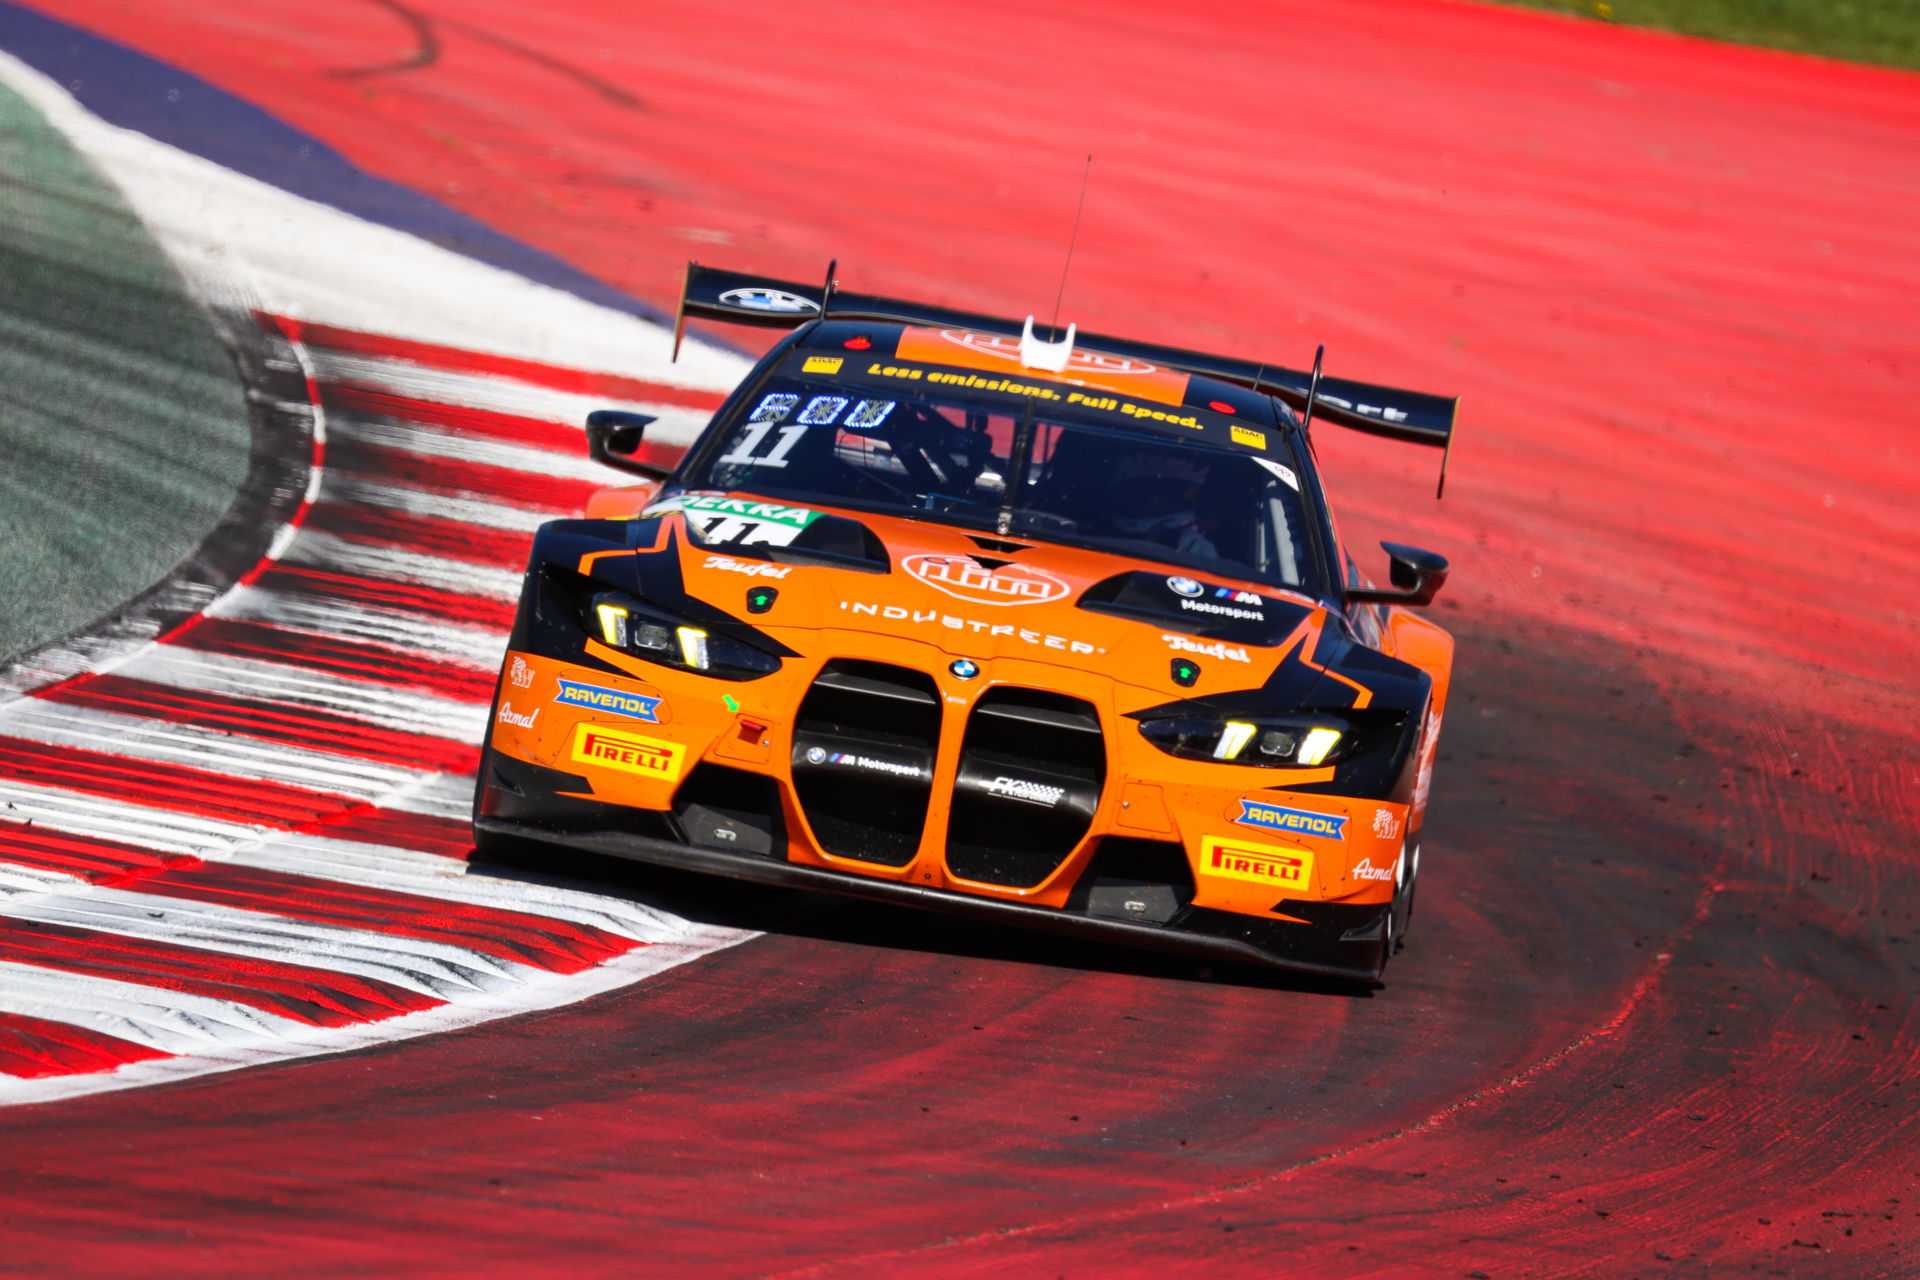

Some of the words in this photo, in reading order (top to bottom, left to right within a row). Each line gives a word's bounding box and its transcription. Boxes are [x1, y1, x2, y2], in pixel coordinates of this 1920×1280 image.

[868, 363, 923, 380] Less
[927, 371, 1061, 400] emissions.
[1067, 392, 1118, 411] Full
[1120, 403, 1204, 430] Speed.
[719, 421, 808, 468] 11
[1233, 427, 1264, 440] ADAC
[702, 556, 792, 579] Teufel
[1181, 599, 1264, 621] Motorsport
[840, 601, 1095, 655] INDUSTREER
[1161, 634, 1251, 663] Teufel
[564, 686, 650, 715] RAVENOL
[583, 733, 673, 771] PIRELLI
[858, 756, 920, 776] Motorsport
[1248, 807, 1337, 834] RAVENOL
[1211, 845, 1303, 881] PIRELLI
